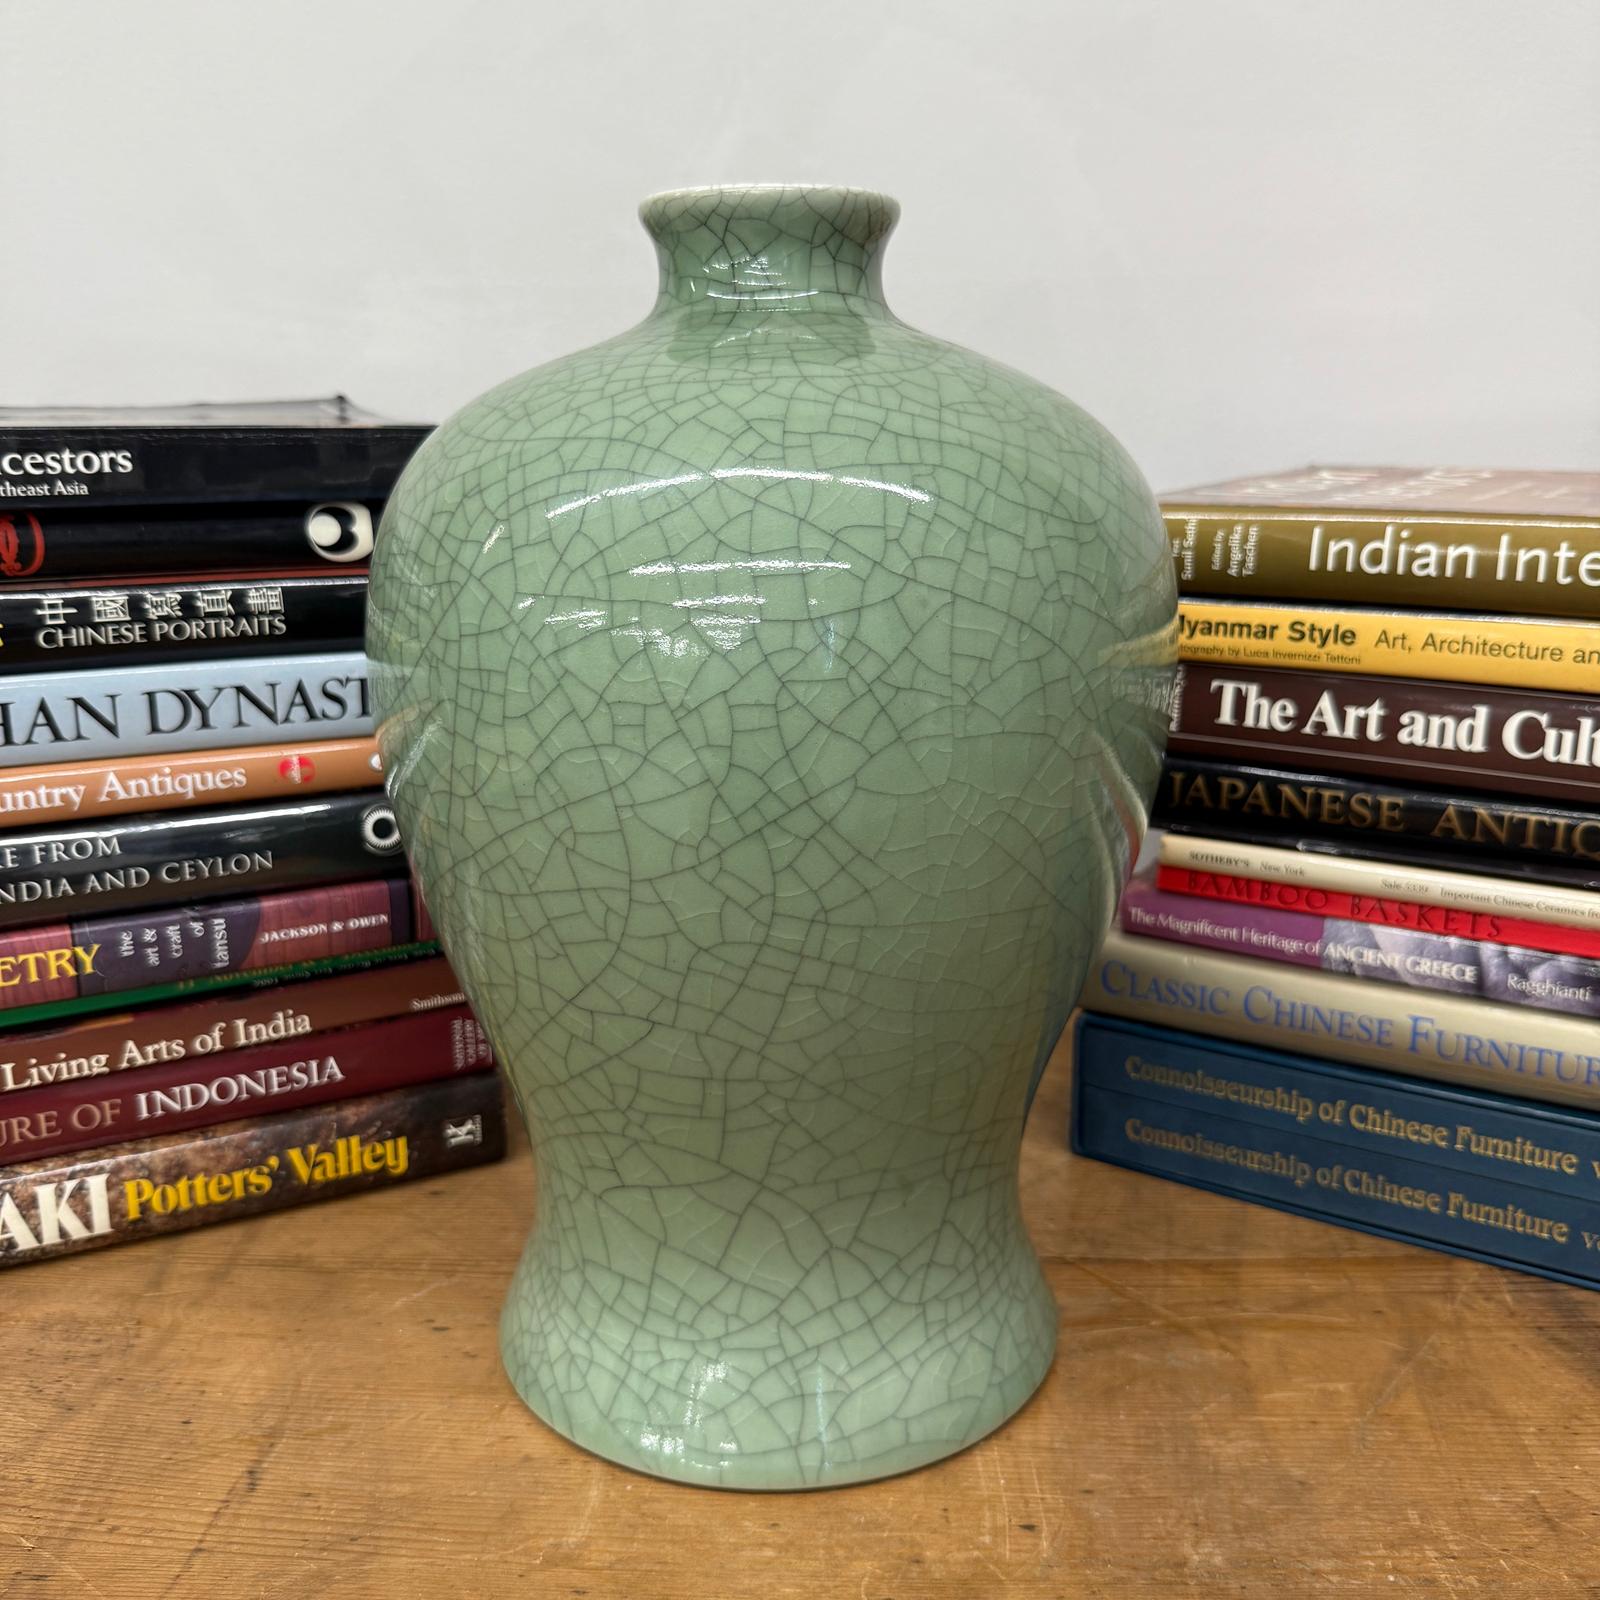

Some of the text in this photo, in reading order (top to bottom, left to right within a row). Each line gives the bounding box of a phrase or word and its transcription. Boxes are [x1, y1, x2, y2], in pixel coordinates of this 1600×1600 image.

[0, 448, 133, 476] cestors
[54, 480, 89, 496] Asia
[1181, 551, 1194, 580] Sunil
[1211, 543, 1222, 570] Edited
[1227, 525, 1242, 577] Angelika
[1242, 525, 1258, 577] Taschen
[1309, 523, 1600, 587] Indian Inte
[37, 614, 287, 649] CHINESE PORTRAITS
[1228, 645, 1240, 657] by
[1288, 621, 1356, 649] Style
[1374, 630, 1412, 653] Art,
[1421, 633, 1564, 663] Architecture
[142, 676, 373, 736] DYNAST
[1210, 678, 1298, 733] The
[1300, 689, 1388, 742] Art
[1397, 703, 1490, 753] and
[98, 767, 247, 802] Antiques
[1169, 770, 1407, 833] JAPANESE
[0, 836, 122, 869] E FROM
[83, 866, 150, 894] AND
[160, 850, 273, 883] CEYLON
[1188, 870, 1500, 938] BAMBOO BASKETS
[1189, 851, 1249, 867] SOTHEBY'S
[1259, 861, 1281, 874] New
[1283, 864, 1305, 877] York
[1381, 879, 1402, 891] Sale
[1441, 887, 1491, 904] Important
[1494, 894, 1534, 909] Chinese
[1536, 901, 1585, 917] Ceramics
[120, 930, 135, 958] the
[142, 927, 160, 967] art &
[165, 923, 183, 959] craft
[189, 920, 204, 938] of
[208, 918, 230, 969] tansu
[260, 913, 389, 944] JACKSON & OWEN
[0, 944, 101, 987] ETRY
[1129, 906, 1593, 1001] The Magnificent Heritage of ANCIENT GREECE Ragghianti
[1101, 959, 1230, 1015] CLASSIC
[1243, 985, 1393, 1048] CHINESE
[1, 1009, 312, 1092] Living Arts of India
[71, 1098, 122, 1131] OF
[135, 1056, 346, 1121] INDONESIA
[1125, 1056, 1312, 1122] Connoisseurship
[1318, 1100, 1347, 1125] of
[1349, 1103, 1449, 1148] Chinese
[1454, 1124, 1579, 1175] Furniture
[0, 1135, 409, 1251] AKI Potters' Valley
[1125, 1118, 1311, 1188] Connoisseurship
[1315, 1164, 1343, 1190] of
[1343, 1169, 1442, 1214] Chinese
[1447, 1190, 1570, 1244] Furniture
